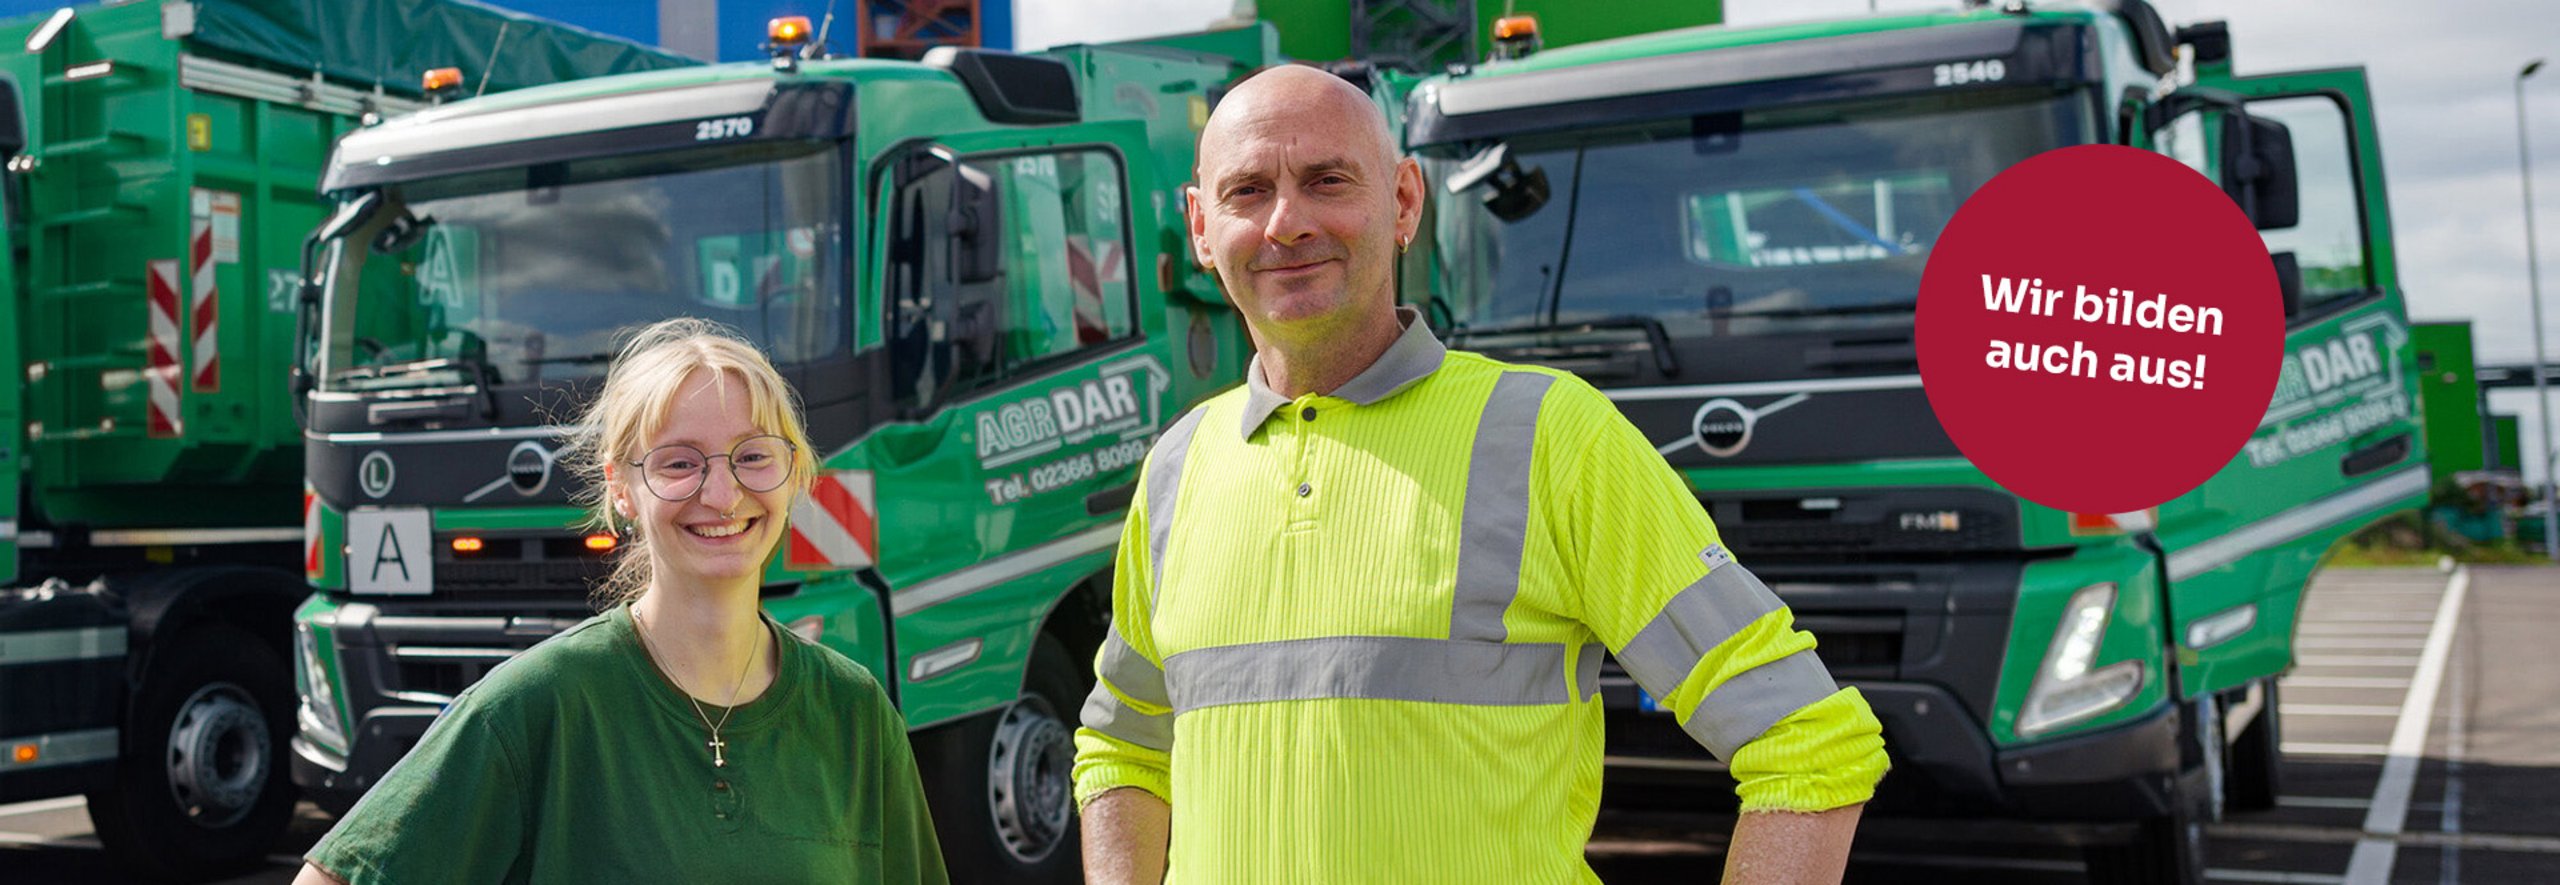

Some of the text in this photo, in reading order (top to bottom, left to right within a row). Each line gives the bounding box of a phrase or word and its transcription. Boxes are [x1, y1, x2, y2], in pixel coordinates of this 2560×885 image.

[1934, 59, 2005, 87] 2540
[695, 116, 753, 141] 2570
[369, 460, 384, 490] L
[986, 474, 1030, 504] Tel.
[1031, 452, 1094, 490] 02366
[371, 522, 410, 582] A
